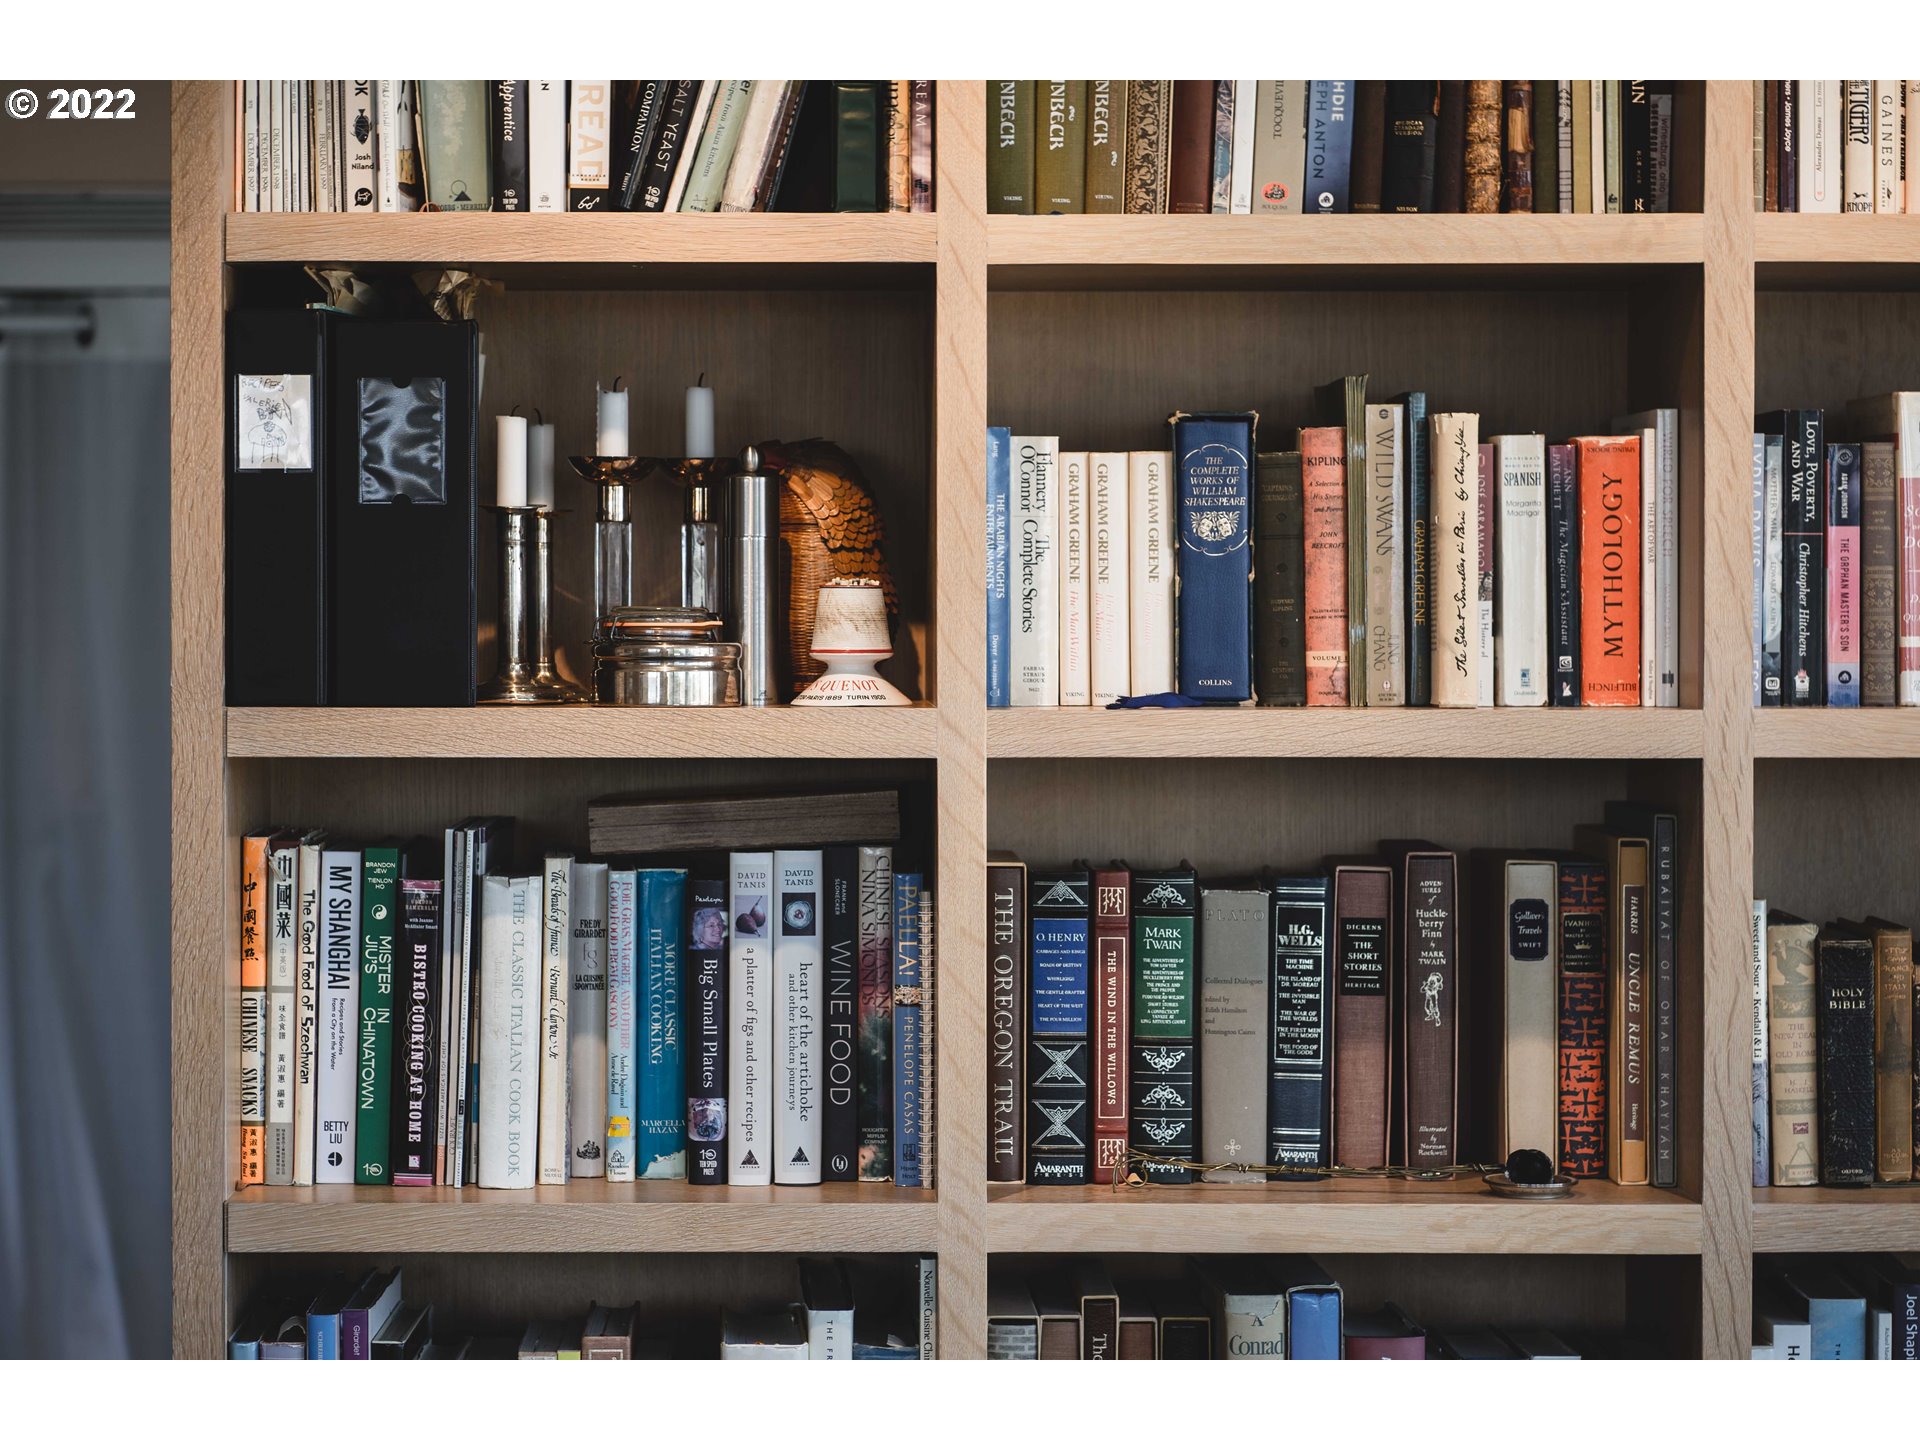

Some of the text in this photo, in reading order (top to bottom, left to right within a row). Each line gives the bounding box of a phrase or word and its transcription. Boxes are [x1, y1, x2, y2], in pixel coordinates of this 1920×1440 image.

[630, 82, 656, 153] COMPANION
[656, 80, 692, 172] SALT YEAST
[1848, 88, 1870, 145] TIGER?
[1881, 95, 1893, 167] GAINES
[247, 132, 255, 192] DECEMBER 1997
[260, 132, 268, 192] DECEMBER 1996
[351, 162, 375, 171] Niland
[354, 154, 372, 162] Josh
[1847, 202, 1873, 212] KNOPF
[1190, 465, 1240, 475] COMPLETE
[1204, 456, 1224, 466] THE
[1032, 451, 1054, 513] Flannery
[1189, 475, 1241, 485] WORKS OF
[1191, 485, 1239, 496] WILLIAM
[1374, 428, 1395, 557] WILD SWANS
[1503, 473, 1543, 486] SPANISH
[1552, 453, 1562, 511] PATCHETT
[1563, 467, 1573, 493] ANN
[1840, 472, 1849, 519] ADAM JOHNSON
[1183, 495, 1247, 507] SHAKESPEARE
[1069, 463, 1080, 584] GRAHAM GREENE
[1097, 463, 1109, 585] GRAHAM GREENE
[1148, 462, 1160, 584] GRAHAM GREENE
[996, 493, 1006, 599] THE ARABIAN NIGHTS
[1036, 535, 1050, 563] The
[1020, 519, 1037, 633] Complete Stories
[1413, 519, 1426, 627] GRAHAM GREENE
[1602, 472, 1624, 658] MYTHOLOGY
[1797, 542, 1811, 657] Christopher Hitchens
[1839, 538, 1850, 652] THE ORPHAN MASTER'S SON
[1587, 682, 1637, 691] BULFINCH
[737, 872, 767, 880] DAVID
[737, 881, 767, 889] TANIS
[784, 869, 815, 877] DAVID
[784, 878, 815, 887] TANIS
[840, 880, 848, 900] FRANK
[327, 865, 353, 990] MY SHANGHAI
[861, 869, 876, 1007] NINA SIMONDS
[875, 855, 891, 1020] CHINESE SEASONS
[897, 884, 919, 977] PAELLA!
[1144, 927, 1182, 939] MARK
[1419, 918, 1445, 931] berry
[1421, 928, 1443, 939] Finn
[1143, 938, 1183, 951] TWAIN
[1278, 935, 1323, 948] WELLS
[1347, 952, 1379, 960] SHORT
[1353, 941, 1374, 949] THE
[1420, 951, 1445, 959] MARK
[1518, 941, 1543, 949] SWIFT
[377, 935, 393, 994] MISTER
[741, 957, 756, 998] platter
[1343, 963, 1384, 972] STORIES
[1418, 958, 1447, 966] TWAIN
[650, 927, 663, 1065] ITALIAN COOKING
[664, 942, 677, 1051] MORE CLASSIC
[1344, 981, 1381, 989] HERITAGE
[1752, 915, 1763, 1058] Sweet and Sour Kendall & Li
[1831, 987, 1866, 998] HOLY
[375, 1007, 390, 1023] IN
[744, 1000, 757, 1014] of
[1627, 895, 1641, 1131] HARRIS UNCLE REMUS Heritage
[1828, 998, 1867, 1010] BIBLE
[506, 890, 526, 1177] THE CLASSIC ITALIAN COOK BOOK
[698, 957, 719, 1088] Big Small Plates
[741, 1015, 757, 1037] figs
[829, 940, 852, 1106] WINE FOOD
[992, 887, 1015, 1164] THE OREGON TRAIL
[1107, 950, 1118, 1106] THE WIND IN THE WILLOWS
[1787, 1023, 1806, 1031] THE
[242, 997, 258, 1116] CHINESE SNACKS
[361, 1006, 378, 1109] CHINATOWN
[408, 943, 427, 1143] BISTRO COOKING AT HOME
[744, 1039, 757, 1062] and
[784, 973, 798, 1112] and other kitchen journeys
[799, 962, 814, 1122] heart of the artichoke
[744, 1064, 757, 1097] other
[903, 1016, 915, 1135] PENELOPE CASAS
[323, 1120, 350, 1131] BETTY
[641, 1119, 686, 1127] MARCELLA
[741, 1100, 755, 1142] recipes
[329, 1134, 345, 1144] LIU
[352, 1324, 361, 1357] Girardet
[825, 1319, 834, 1342] THE
[1228, 1331, 1285, 1356] Conrad
